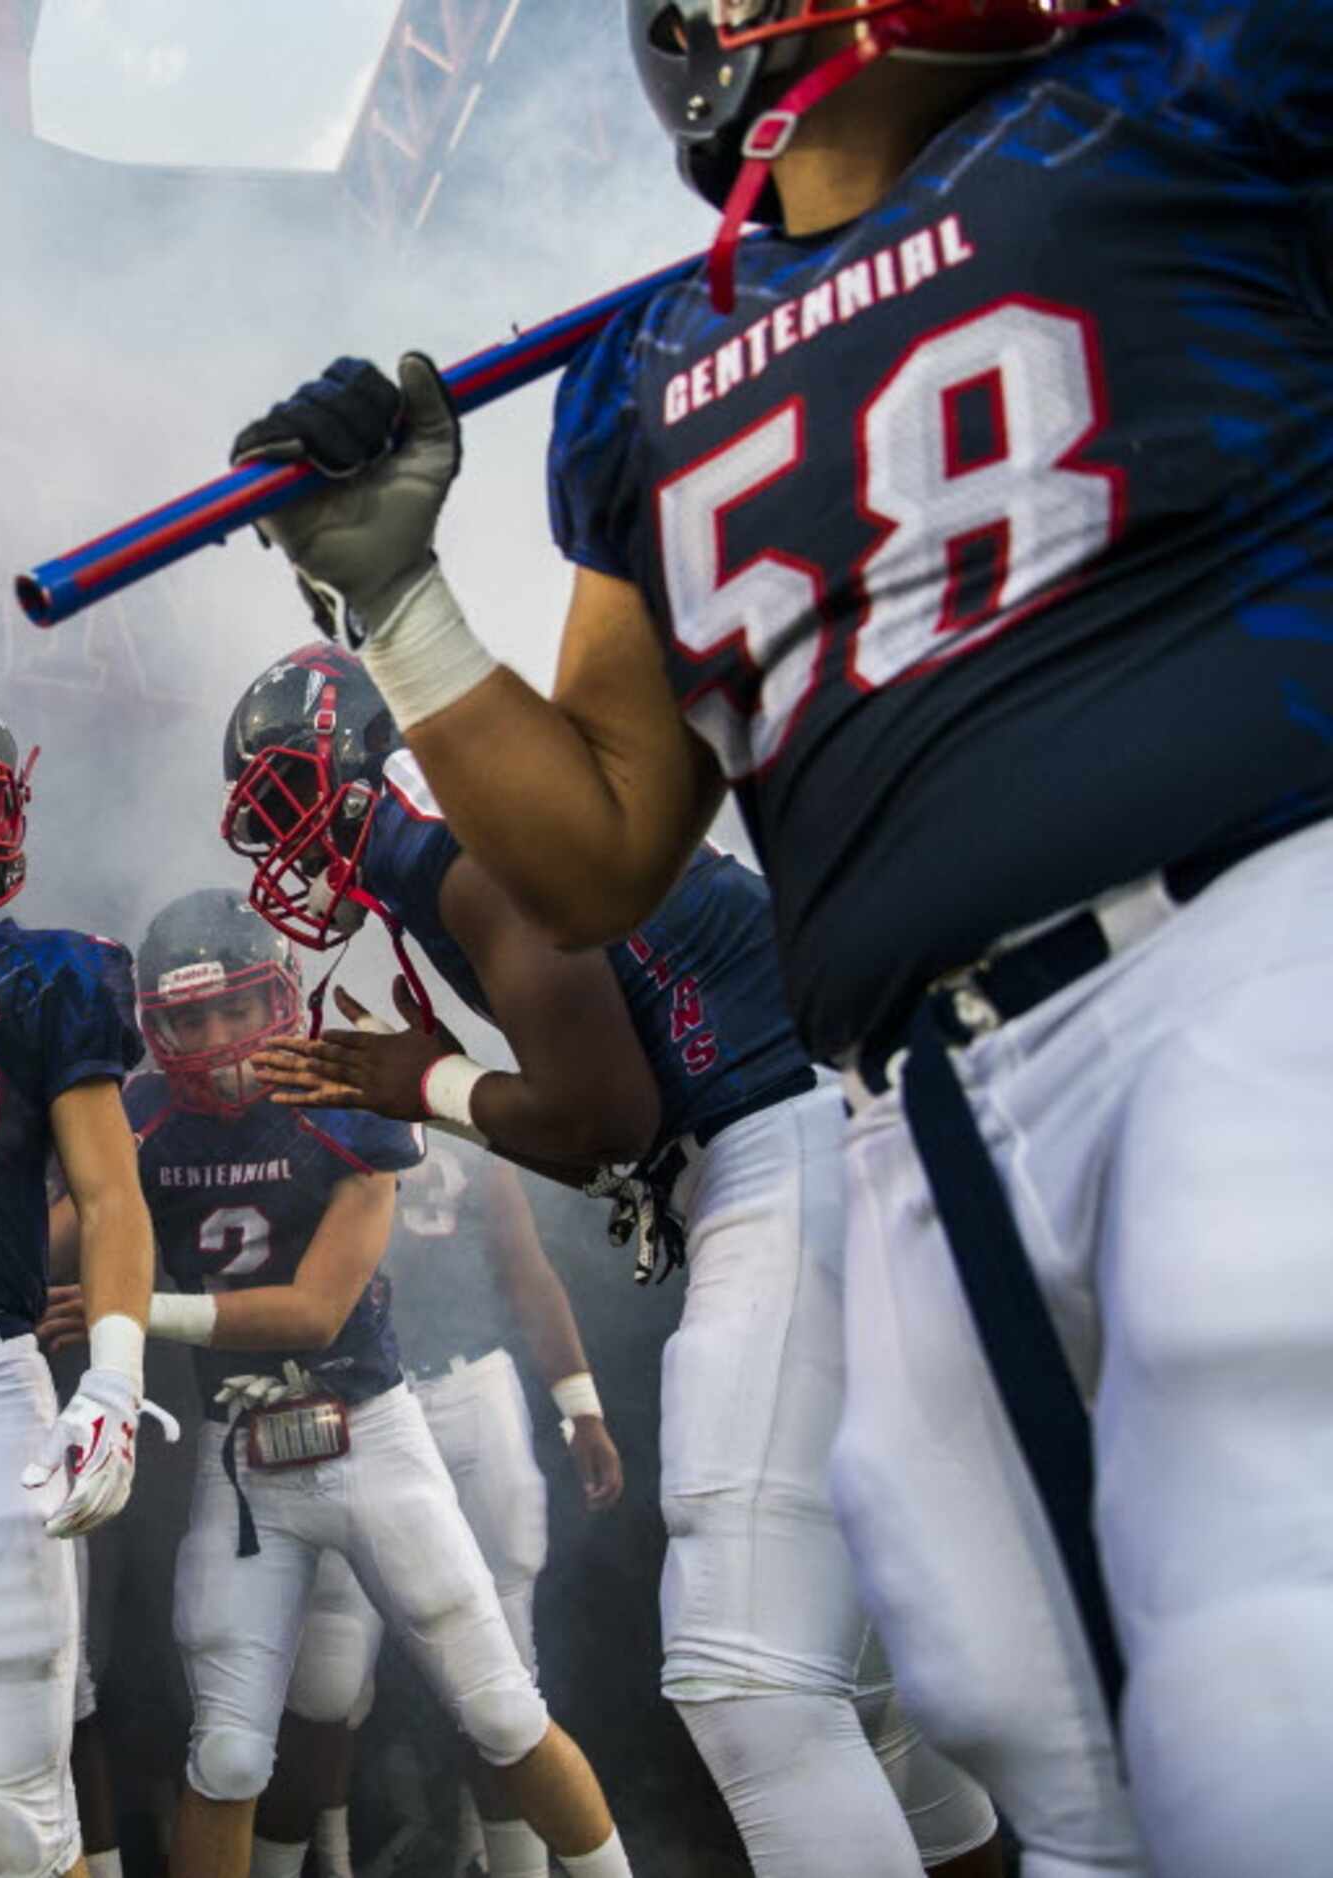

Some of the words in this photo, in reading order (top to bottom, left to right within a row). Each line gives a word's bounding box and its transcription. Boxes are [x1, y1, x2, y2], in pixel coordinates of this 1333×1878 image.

[664, 213, 974, 425] CENTENNIAL
[656, 292, 1129, 785] 58
[159, 1157, 293, 1189] CENTENNIAL
